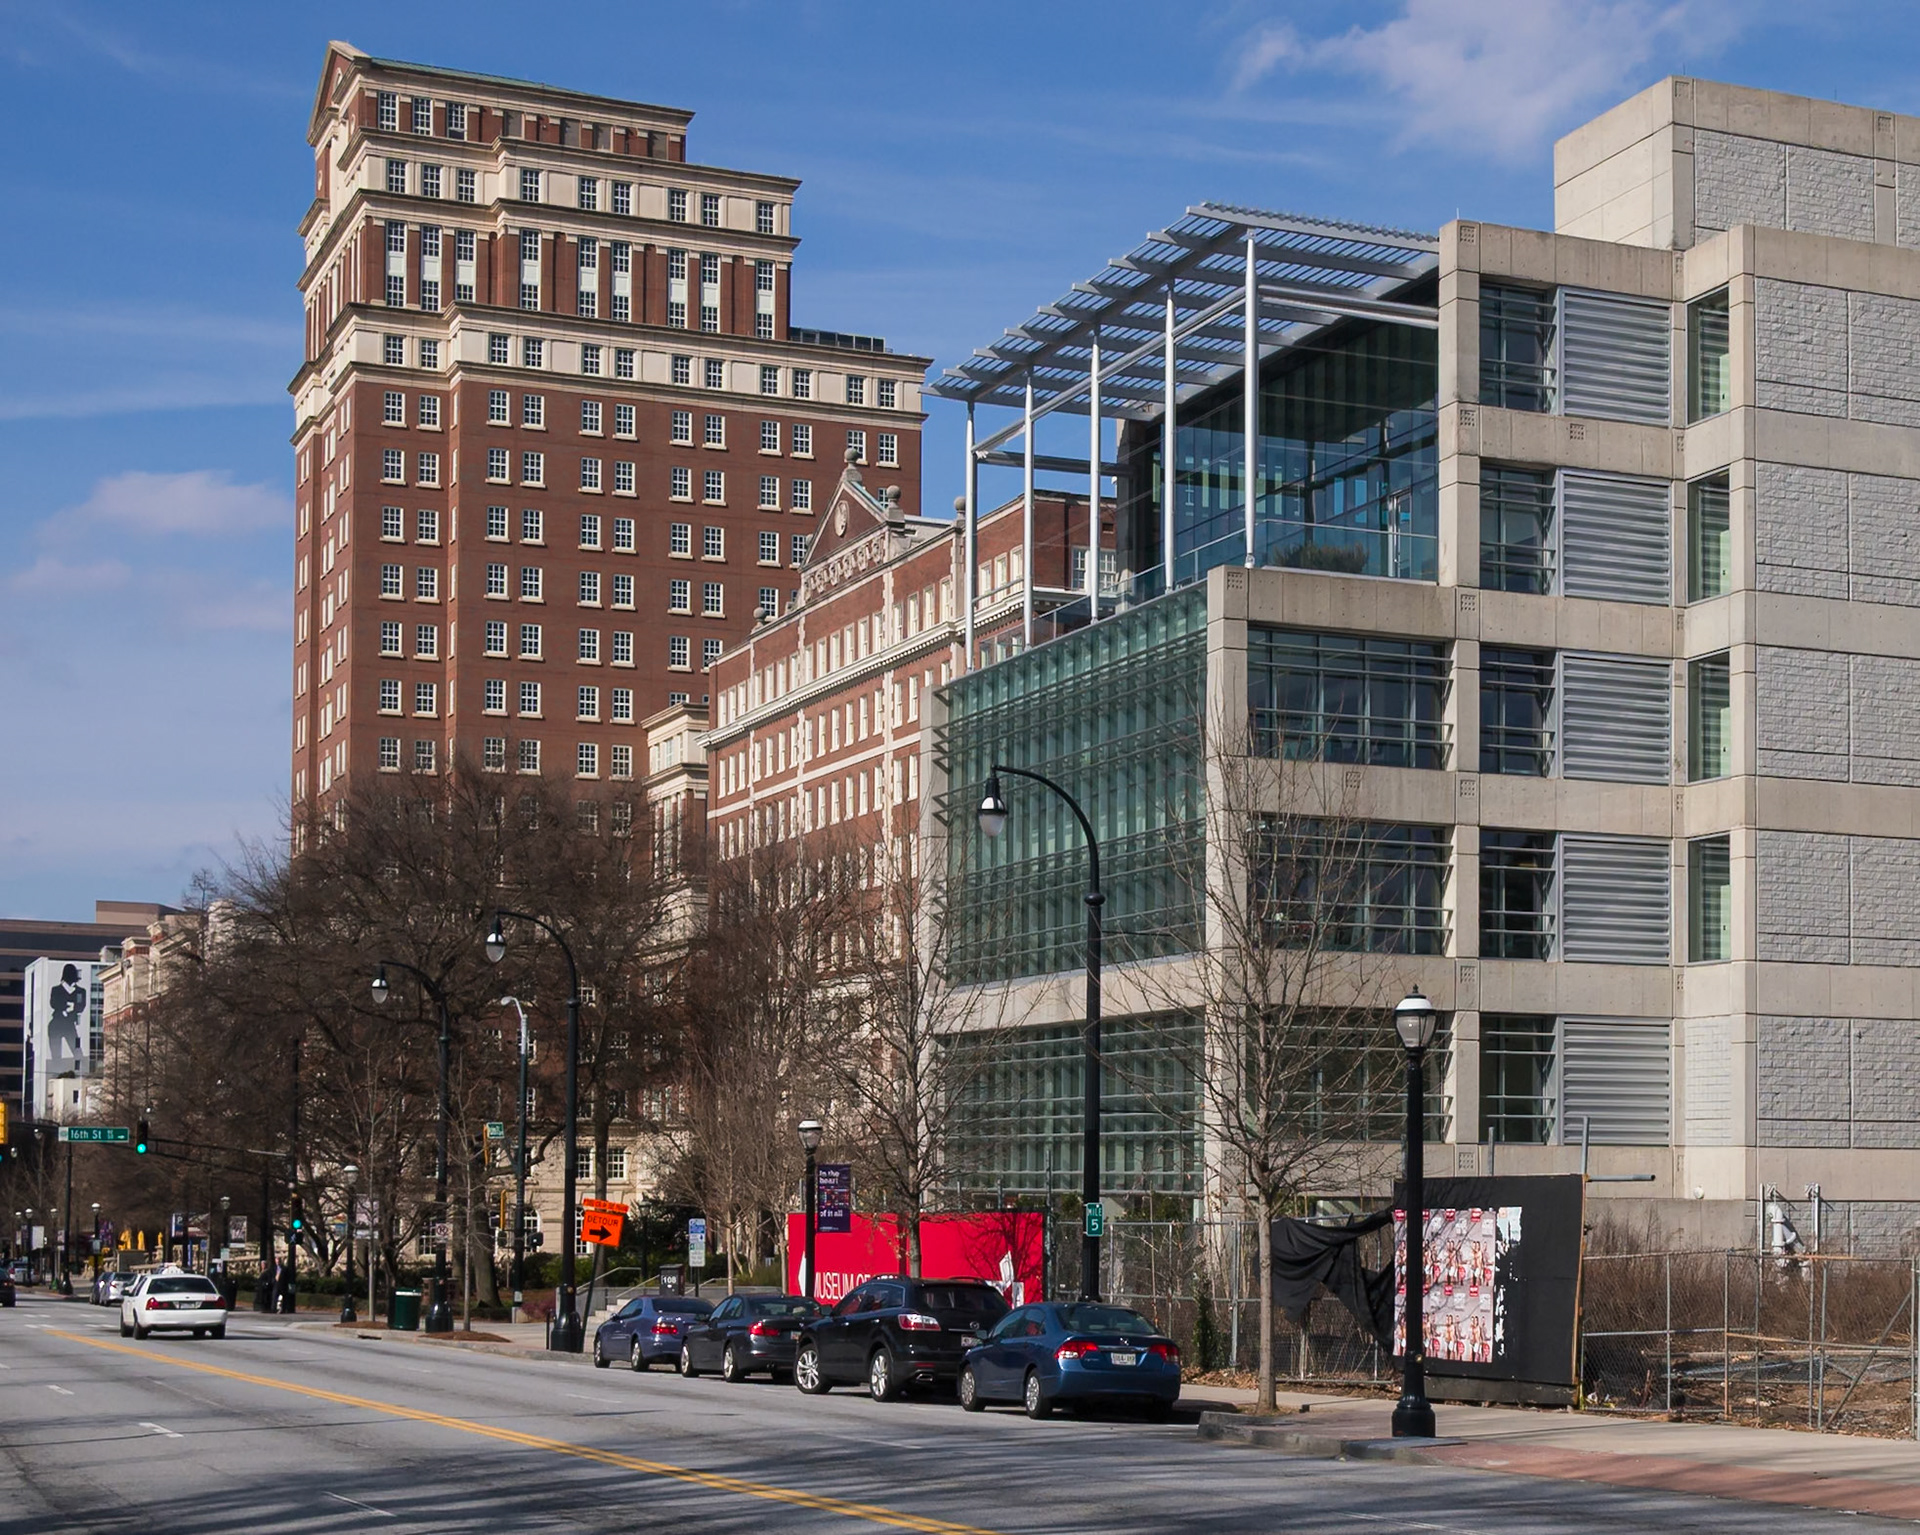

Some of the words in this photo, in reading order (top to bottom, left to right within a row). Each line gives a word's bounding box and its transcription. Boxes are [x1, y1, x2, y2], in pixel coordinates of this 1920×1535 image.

[70, 1130, 89, 1140] 16th
[92, 1130, 102, 1140] St
[587, 1215, 619, 1227] DETOUR
[1091, 1218, 1099, 1231] 5
